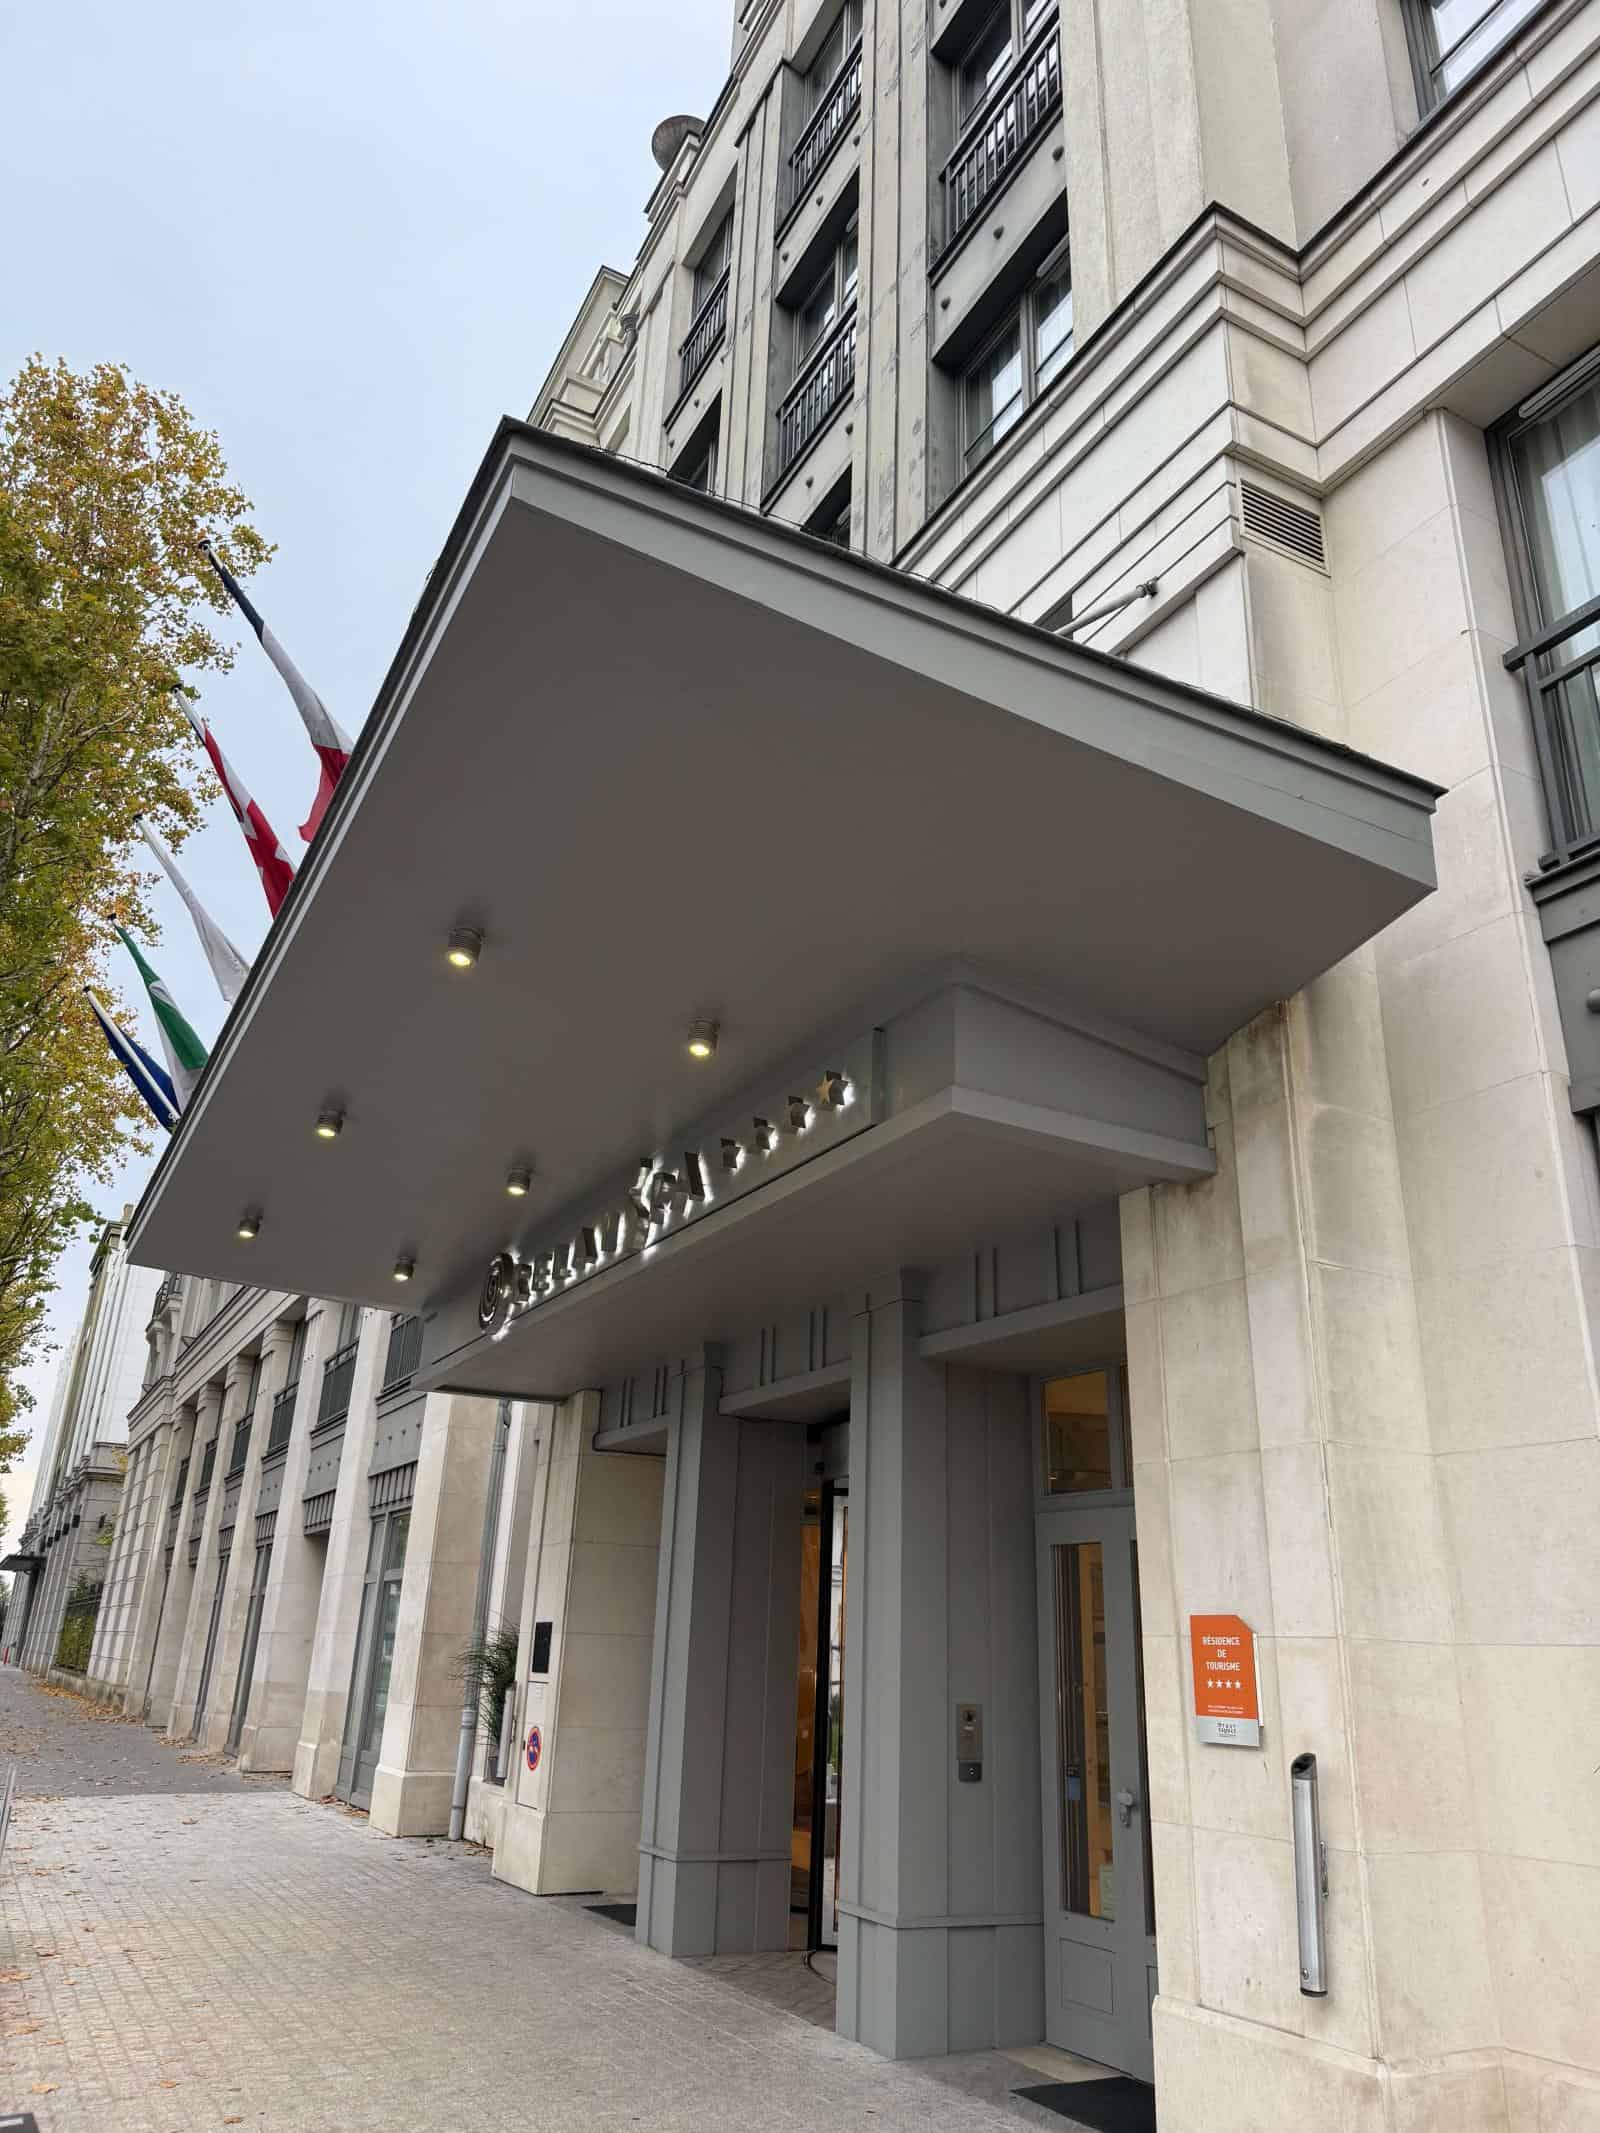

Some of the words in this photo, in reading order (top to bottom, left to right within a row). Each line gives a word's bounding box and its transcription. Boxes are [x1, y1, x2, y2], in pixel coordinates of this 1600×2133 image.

[1202, 1633, 1241, 1646] RÉSIDENCE
[1216, 1649, 1228, 1658] DE
[1205, 1660, 1241, 1672] TOURISME
